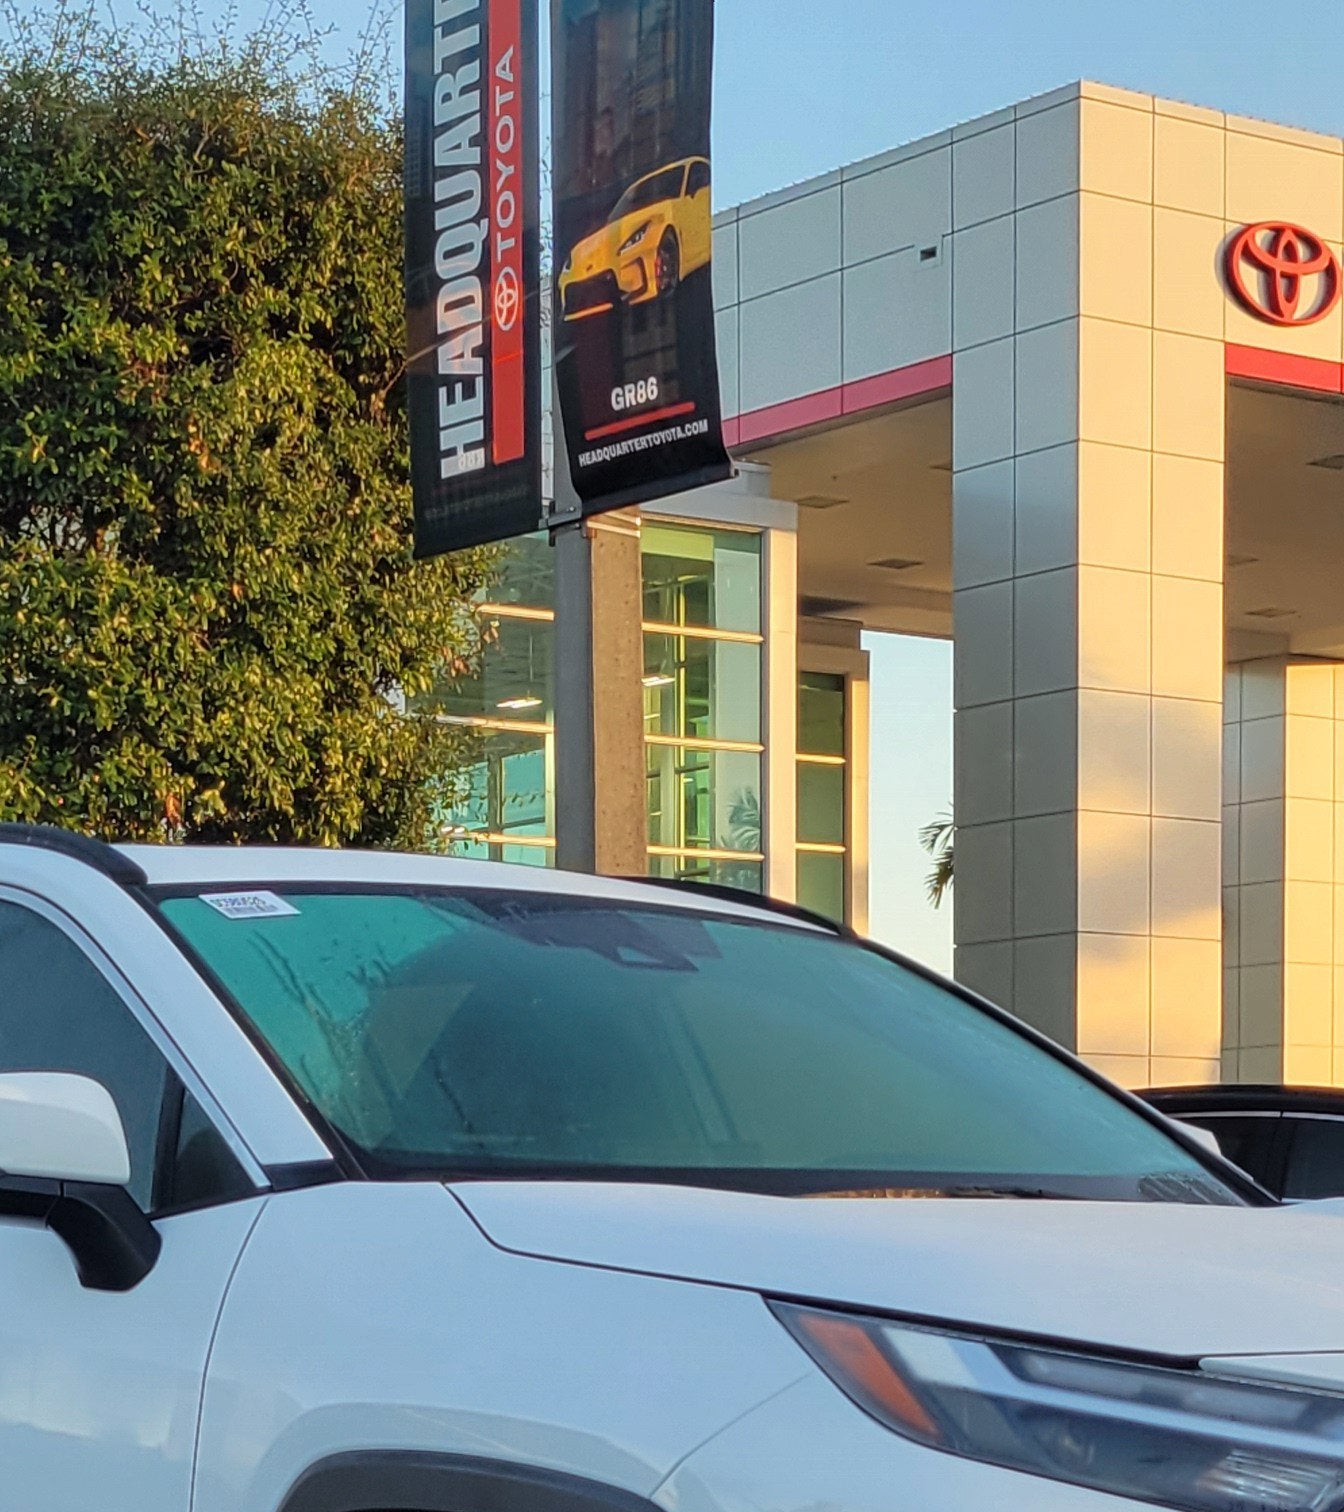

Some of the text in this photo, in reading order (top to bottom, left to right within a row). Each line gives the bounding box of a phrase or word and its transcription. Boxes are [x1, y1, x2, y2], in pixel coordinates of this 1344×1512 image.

[494, 45, 517, 259] TOYOTA
[610, 376, 659, 412] GR86
[577, 418, 709, 468] HEADQUARTERTOYOTA.COM
